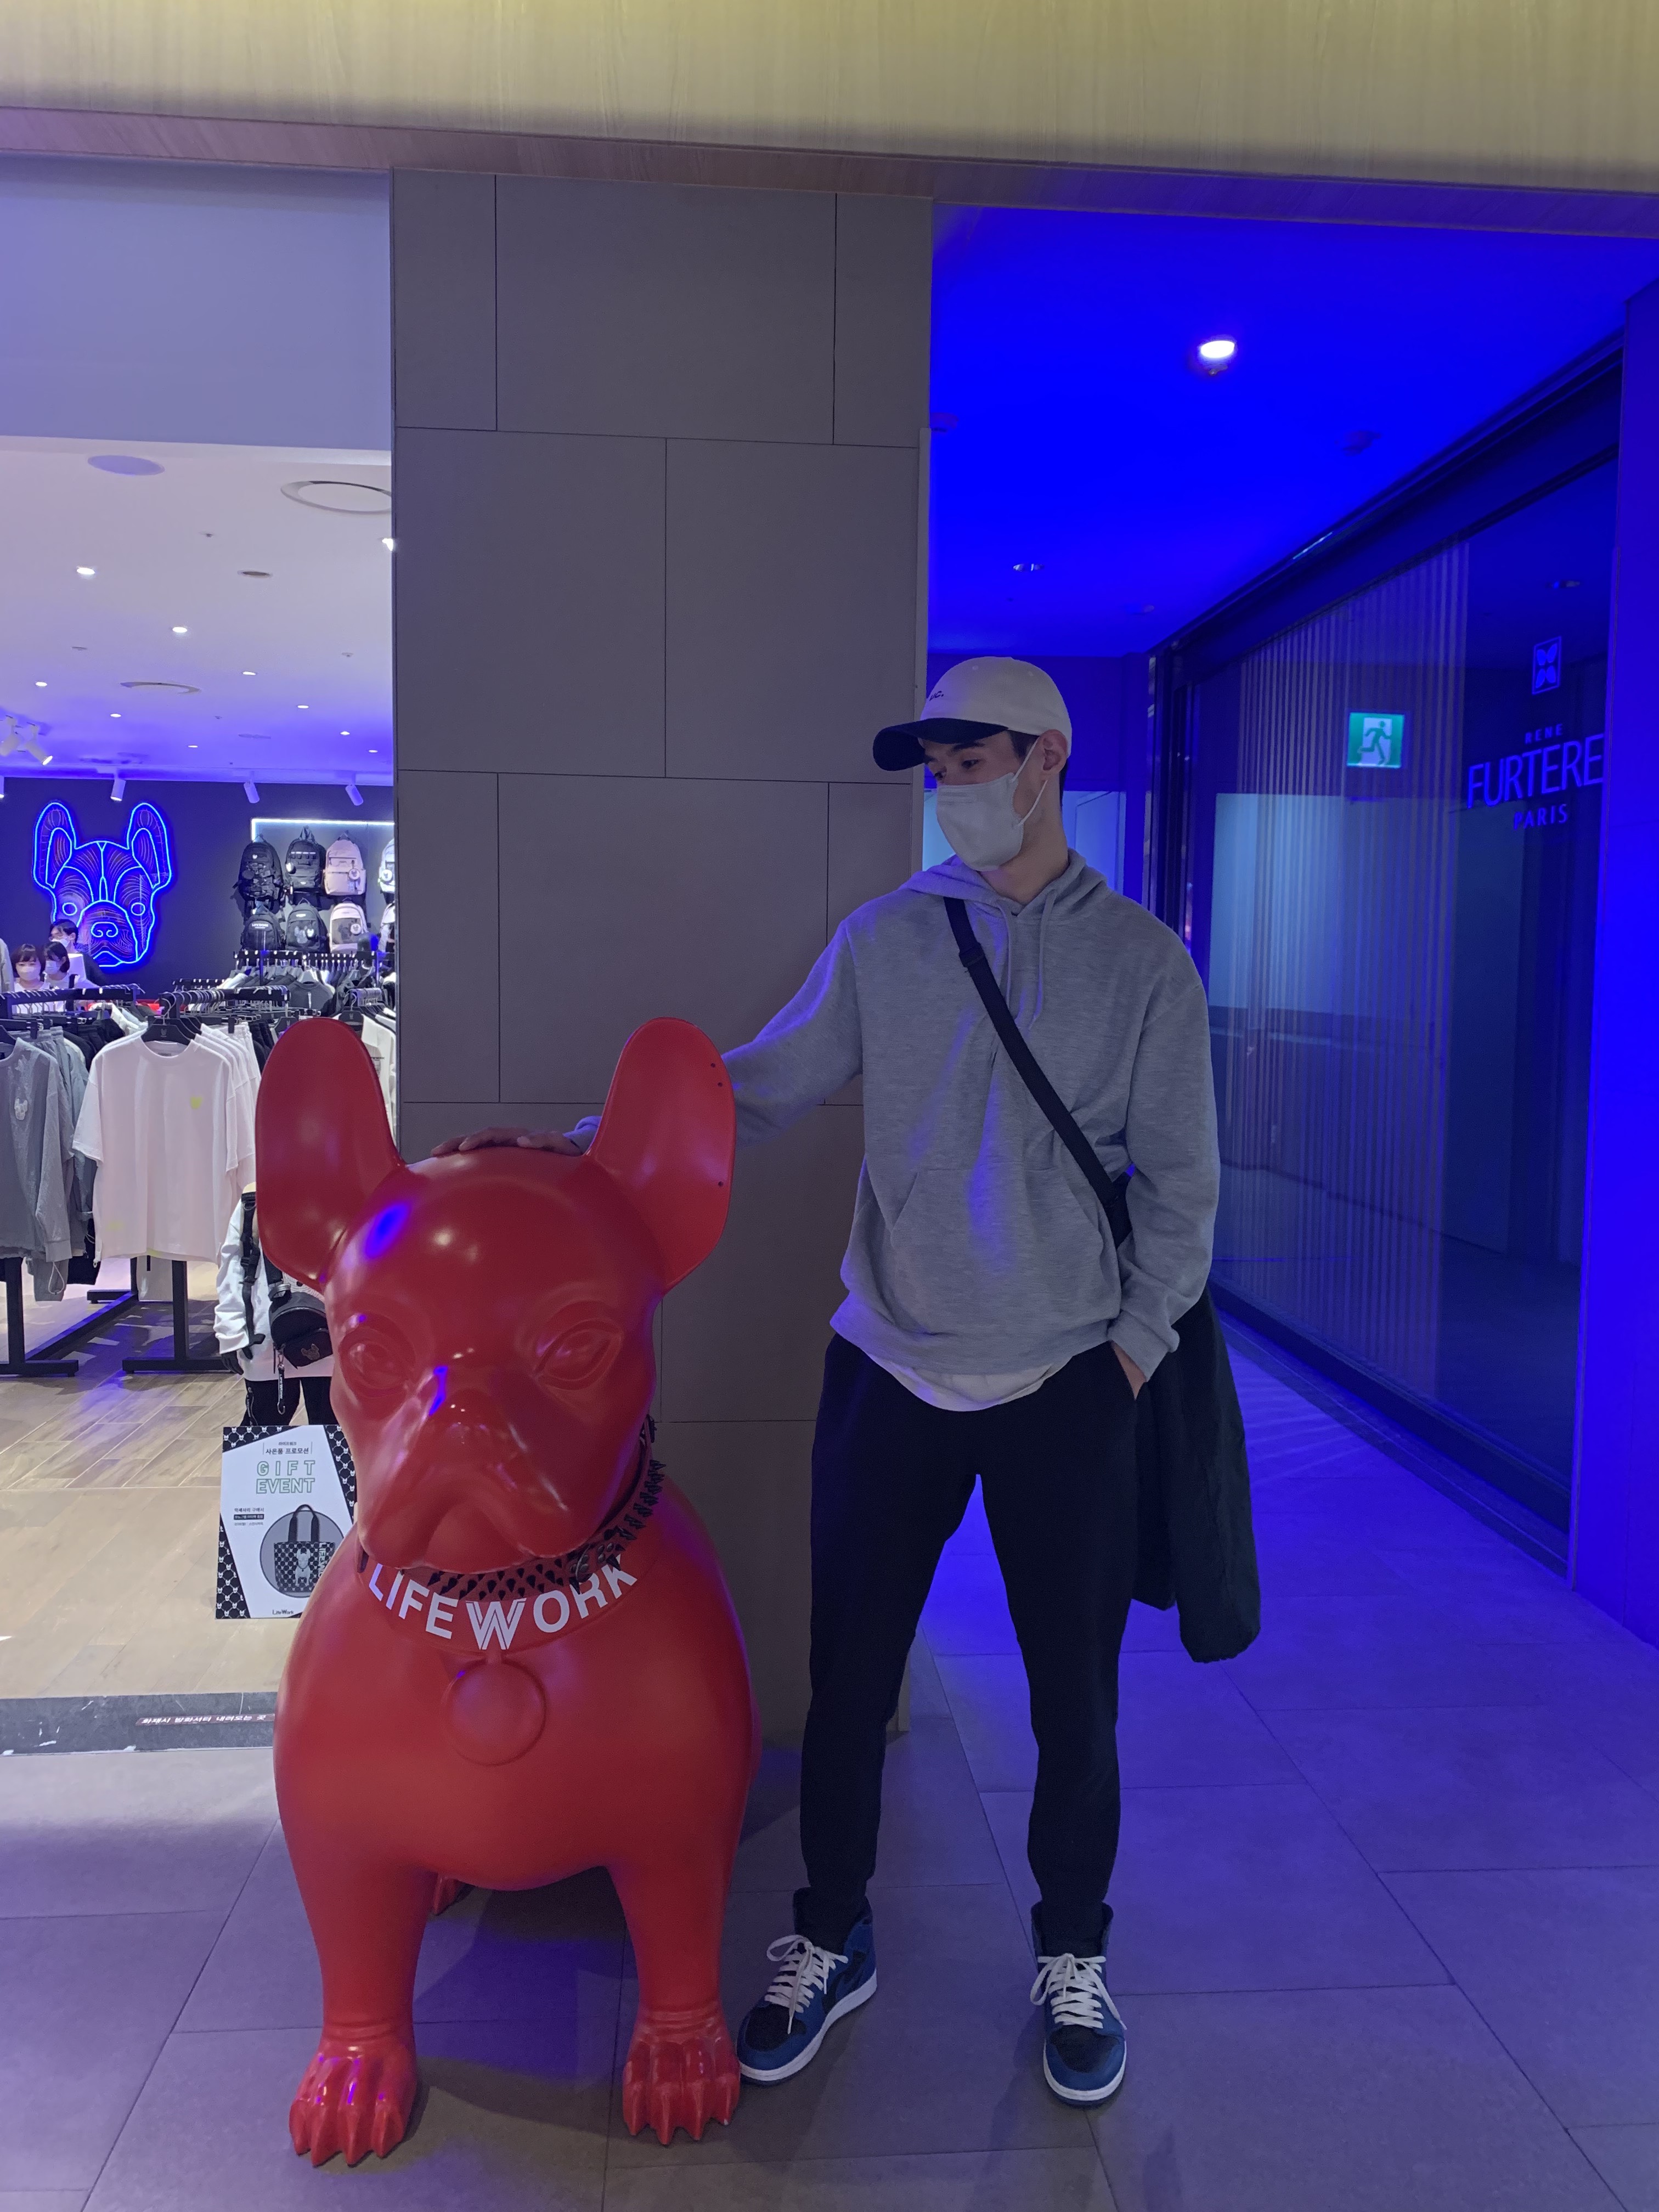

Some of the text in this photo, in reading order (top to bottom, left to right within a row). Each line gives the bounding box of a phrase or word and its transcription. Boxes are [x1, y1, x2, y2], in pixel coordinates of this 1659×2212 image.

[1525, 723, 1562, 744] RENE
[1513, 803, 1568, 830] PARIS
[257, 1460, 315, 1476] GIFT
[256, 1477, 315, 1494] EVENT
[368, 1554, 638, 1650] LIFEWORK
